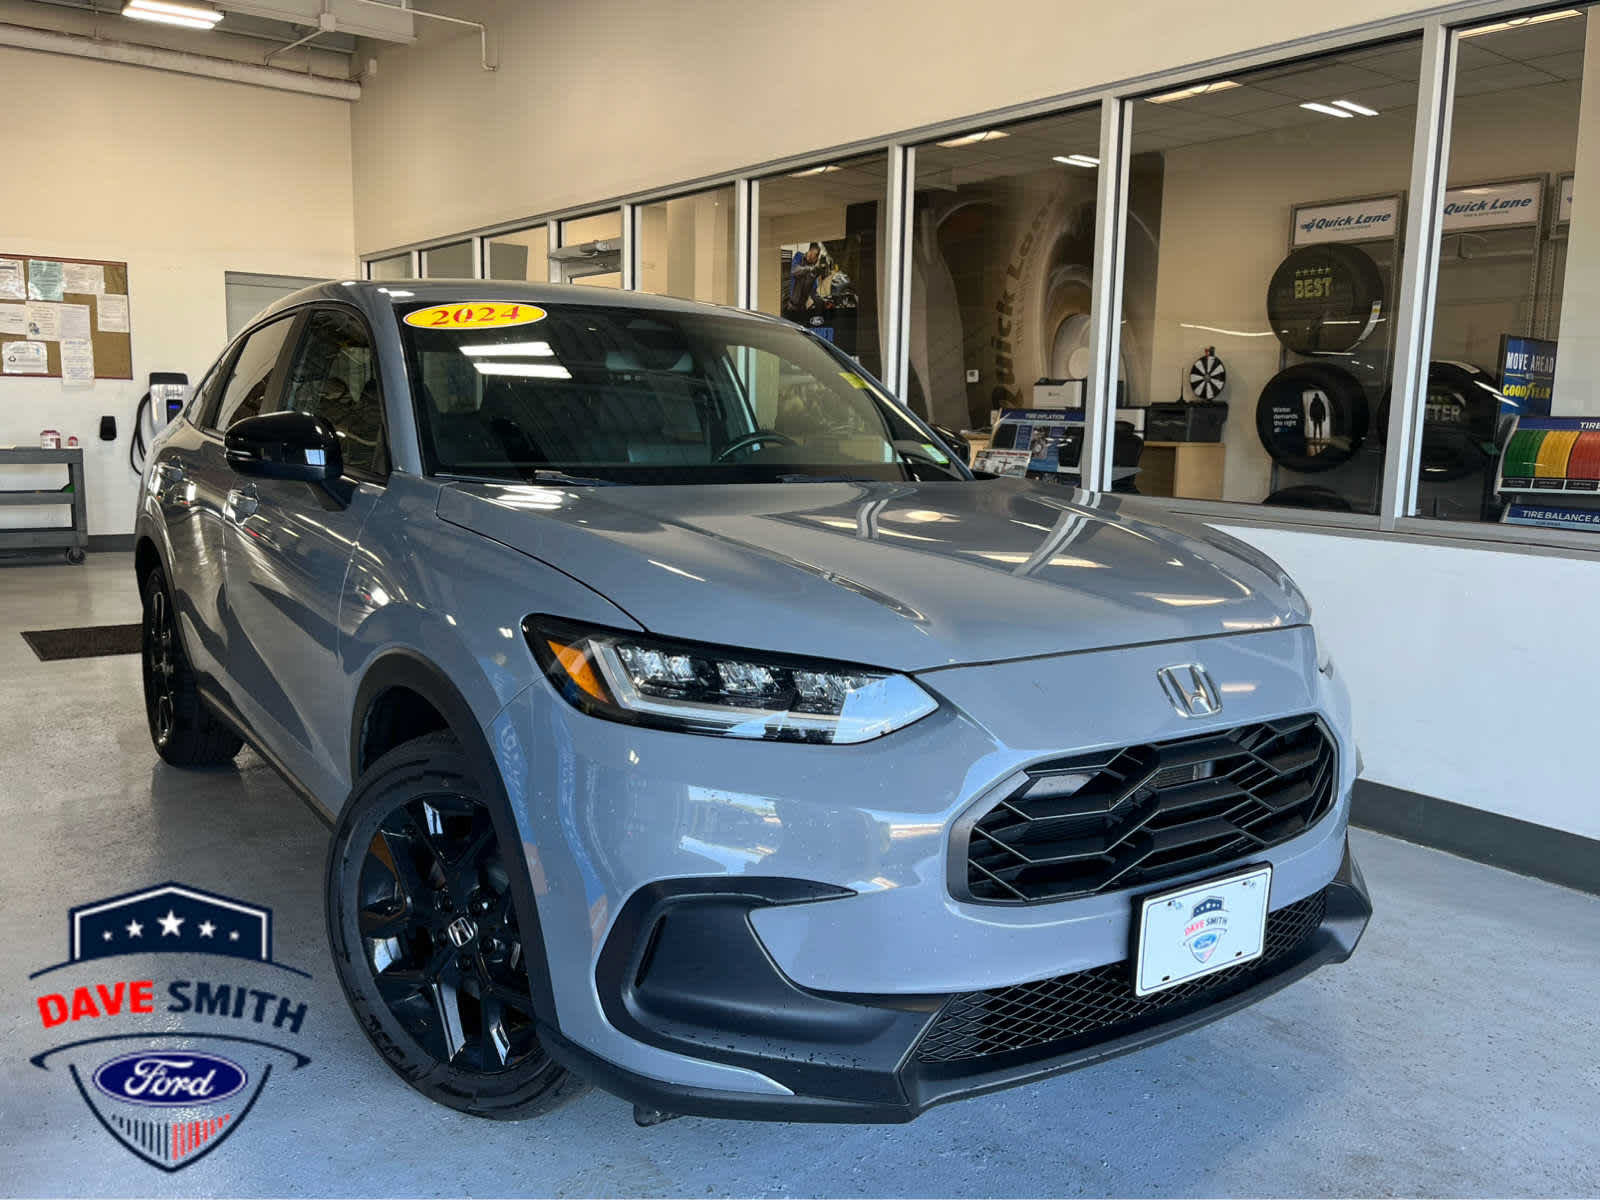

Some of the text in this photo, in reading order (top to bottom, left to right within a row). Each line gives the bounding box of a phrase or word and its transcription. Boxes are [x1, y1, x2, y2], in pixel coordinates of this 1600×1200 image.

[1444, 201, 1486, 215] Quick
[1490, 196, 1532, 210] Lane
[1316, 214, 1352, 230] Quick
[1355, 211, 1391, 224] Lane
[1294, 277, 1333, 299] BEST
[431, 305, 521, 326] 2024
[1505, 351, 1554, 374] MOVE AHEAD
[1580, 421, 1600, 429] TIRE
[1522, 510, 1544, 519] TIRE
[1545, 511, 1592, 522] BALANCE
